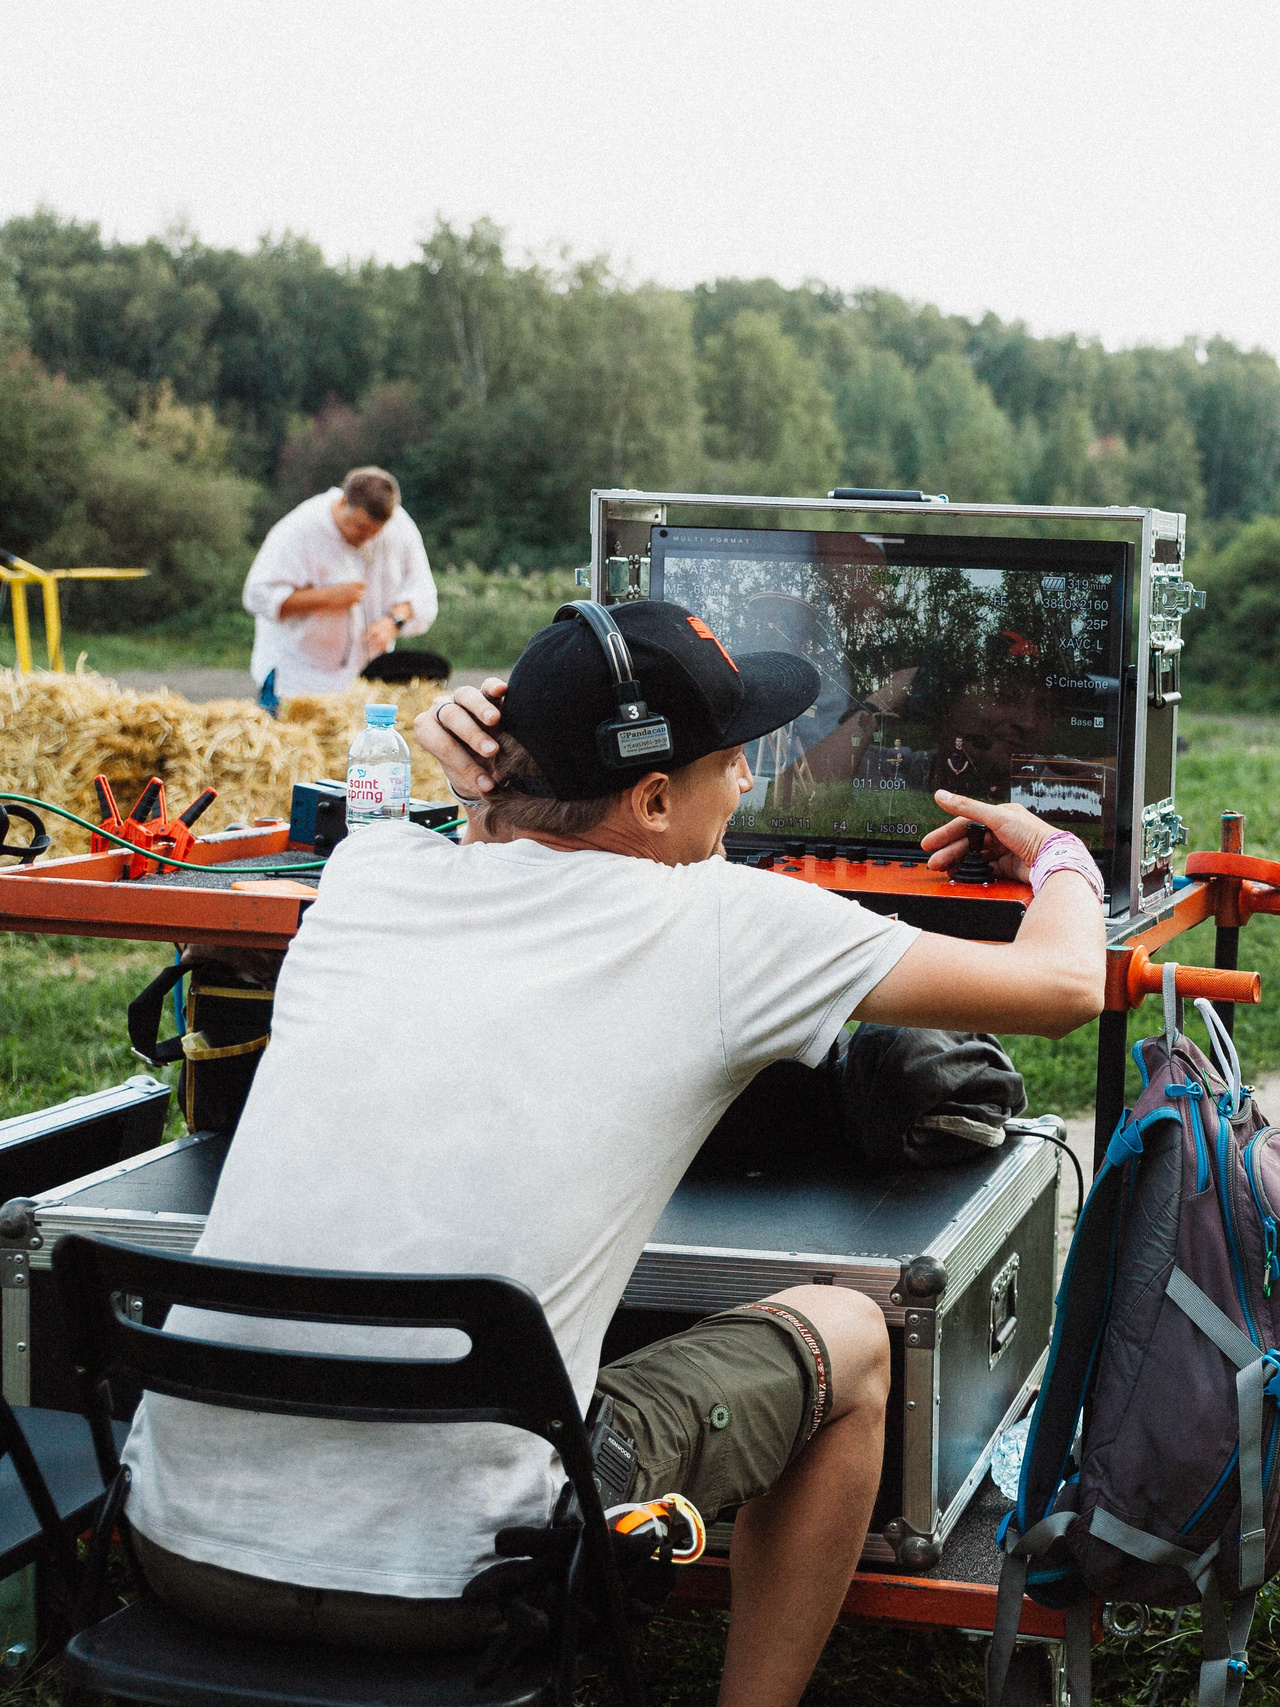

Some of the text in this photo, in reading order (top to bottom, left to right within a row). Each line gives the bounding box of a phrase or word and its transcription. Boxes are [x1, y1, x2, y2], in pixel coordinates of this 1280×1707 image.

[870, 569, 902, 588] Stby
[666, 583, 683, 594] MF
[1086, 619, 1109, 630] 25P
[1045, 676, 1109, 689] S-Cinetone
[628, 705, 640, 720] 3
[1070, 716, 1092, 727] Base
[349, 779, 379, 790] saint
[852, 777, 907, 792] 011_0091
[347, 789, 383, 804] spring
[771, 818, 785, 828] ND
[608, 1437, 632, 1460] KENWOOD
